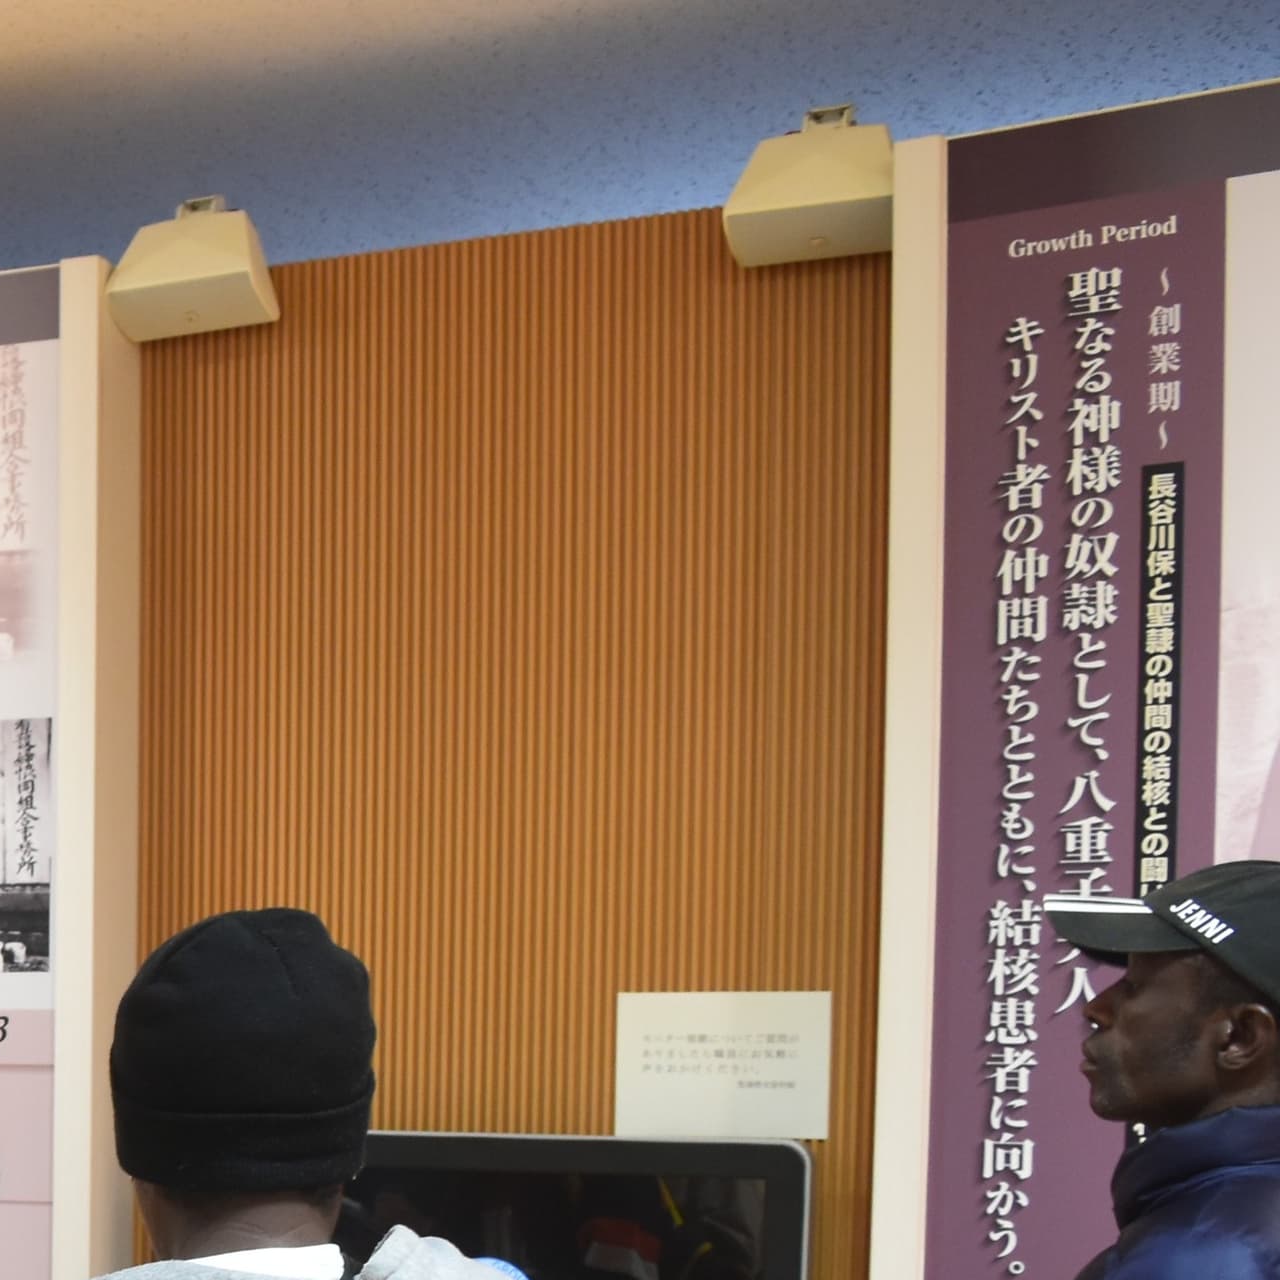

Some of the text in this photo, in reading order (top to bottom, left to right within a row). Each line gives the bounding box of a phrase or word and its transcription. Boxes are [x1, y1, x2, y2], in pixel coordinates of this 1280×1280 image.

[1008, 215, 1178, 259] Growth Period
[983, 316, 1052, 1276] キリスト者の仲間たちとともに、結核患者に向かう。
[1169, 899, 1235, 944] JENNI
